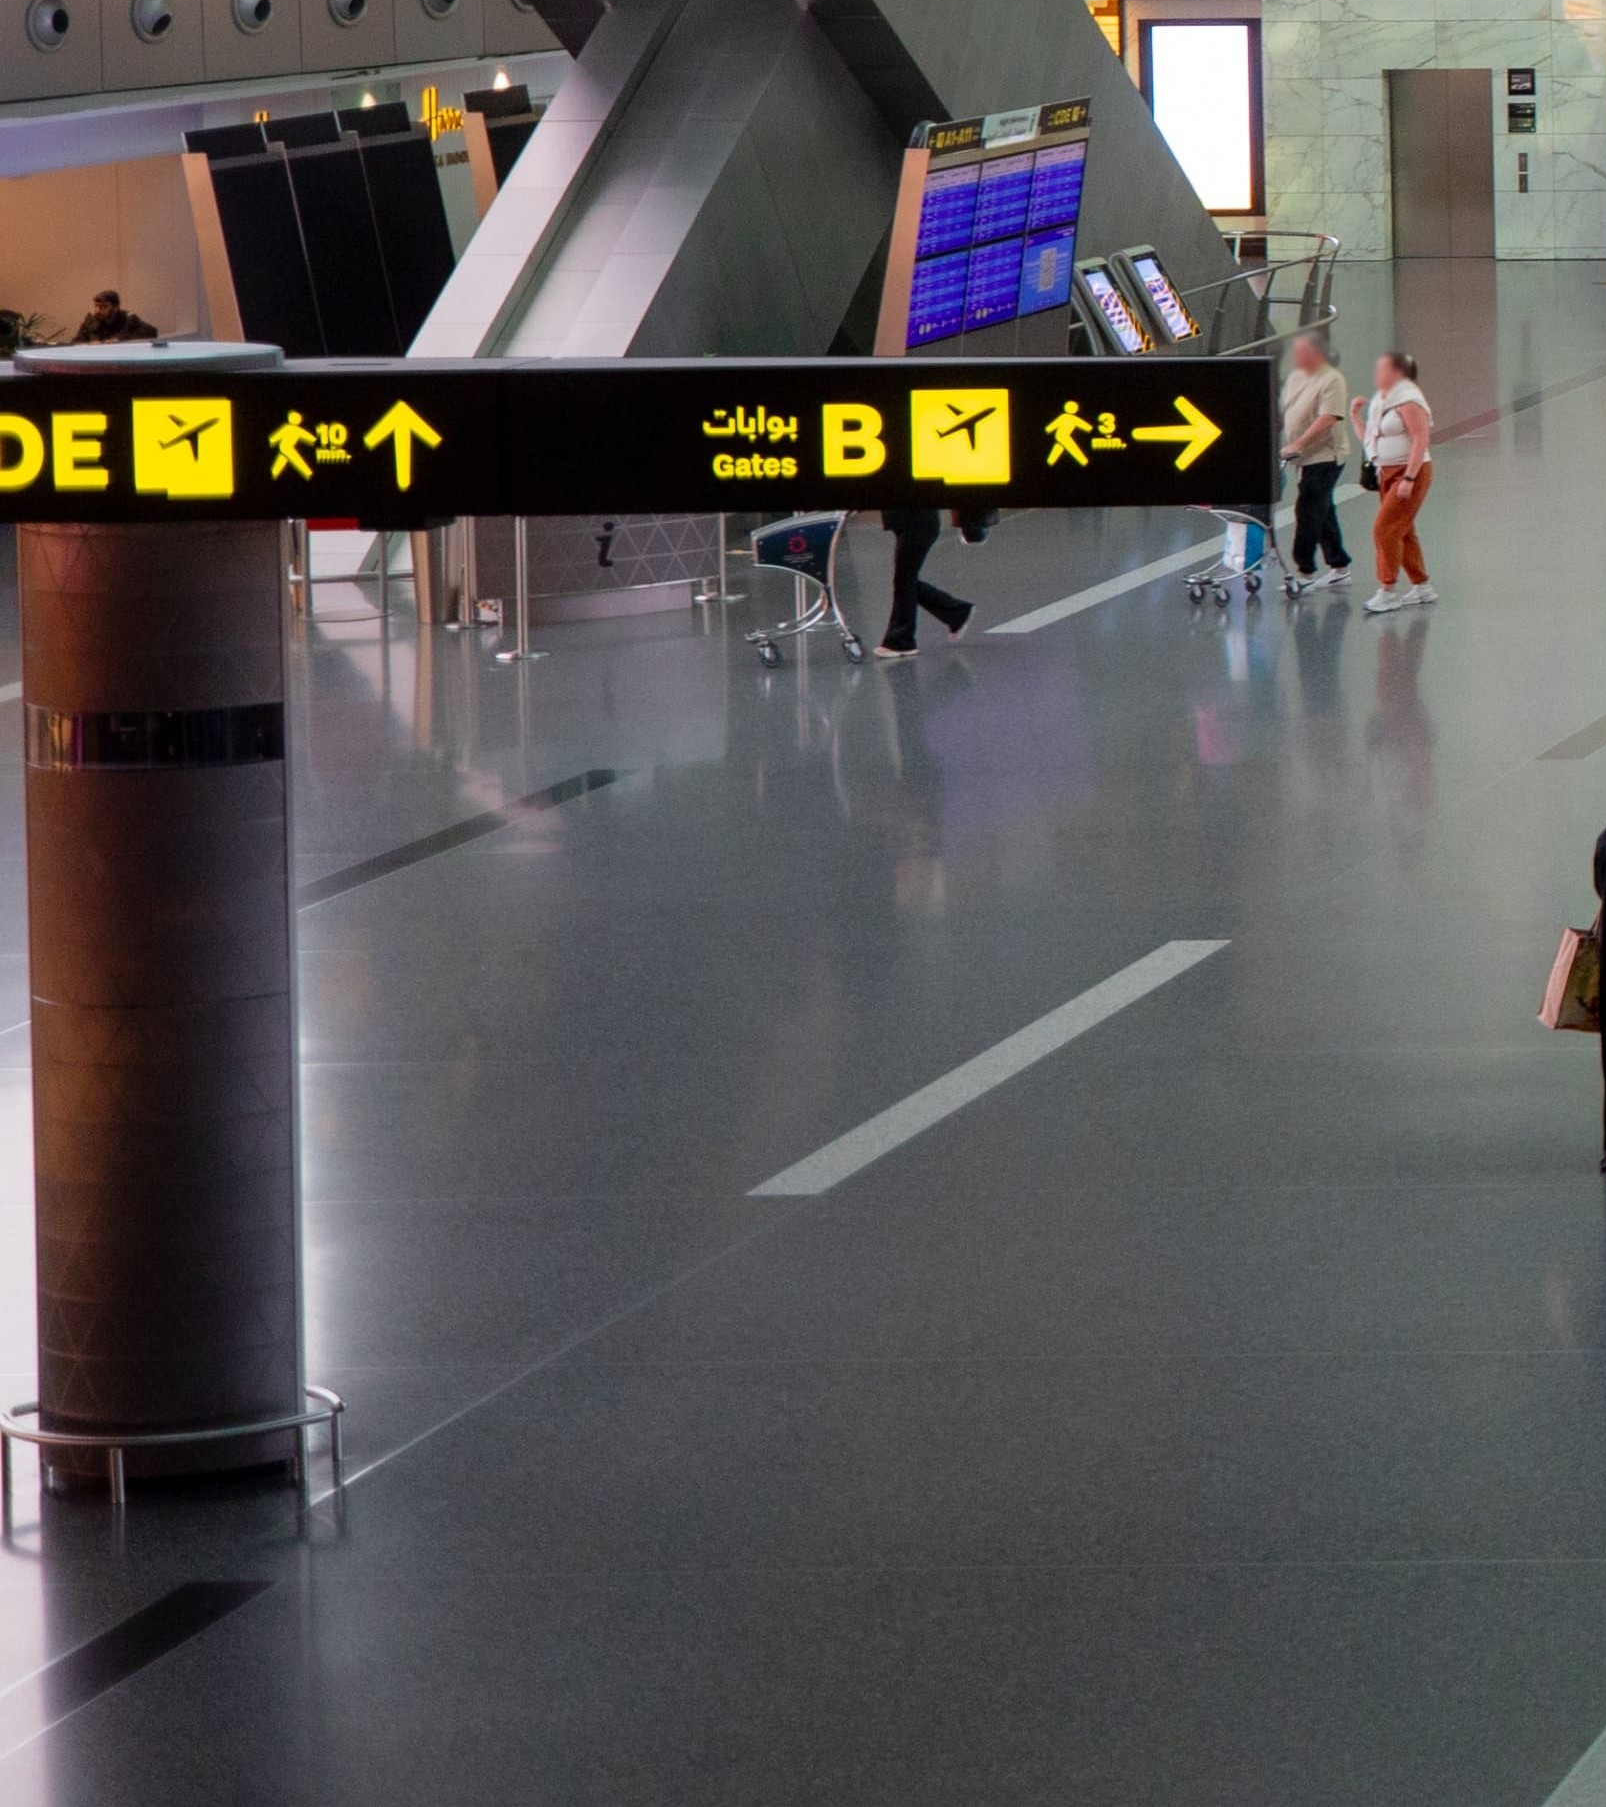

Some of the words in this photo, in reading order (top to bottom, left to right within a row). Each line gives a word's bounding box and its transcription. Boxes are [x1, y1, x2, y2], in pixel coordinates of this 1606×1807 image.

[315, 423, 347, 446] 10
[702, 405, 798, 443] بوابات
[1096, 412, 1116, 434] 3
[822, 403, 887, 477] B
[1091, 433, 1127, 450] min.
[315, 446, 352, 464] min.
[712, 453, 798, 479] Gates
